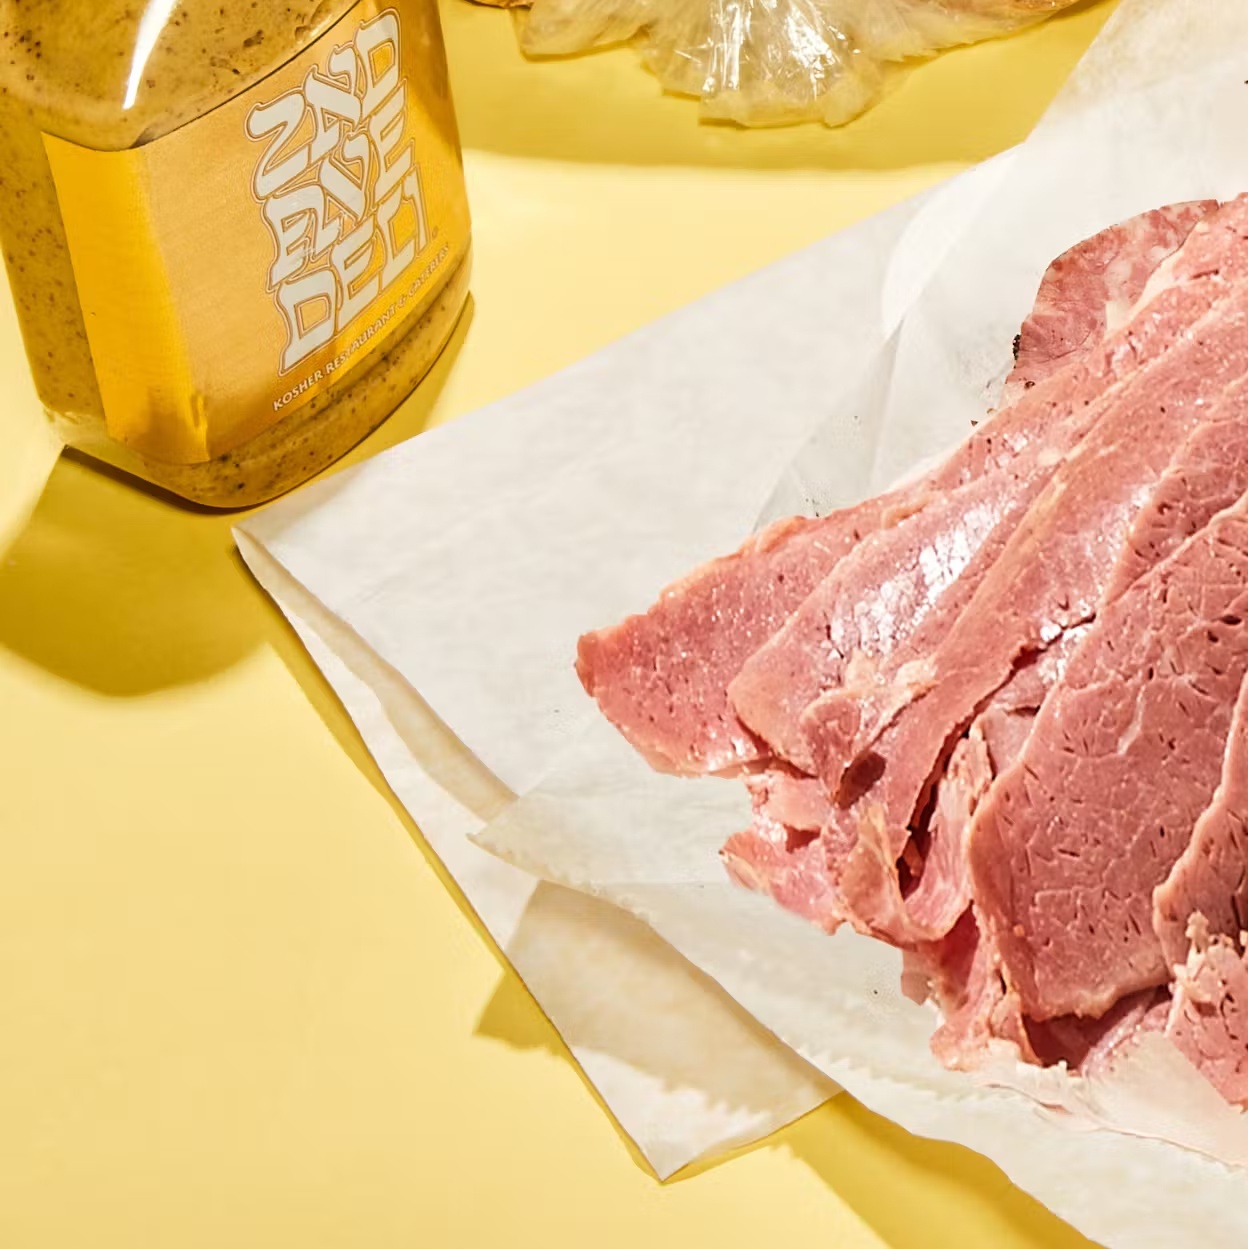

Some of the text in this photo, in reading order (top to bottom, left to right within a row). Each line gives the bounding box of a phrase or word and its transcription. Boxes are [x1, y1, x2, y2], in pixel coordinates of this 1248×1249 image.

[244, 7, 402, 202] 2ND
[263, 79, 416, 293] AVE
[273, 370, 324, 411] KOSHER
[325, 303, 397, 374] RESTAURANT
[276, 164, 429, 376] DELI
